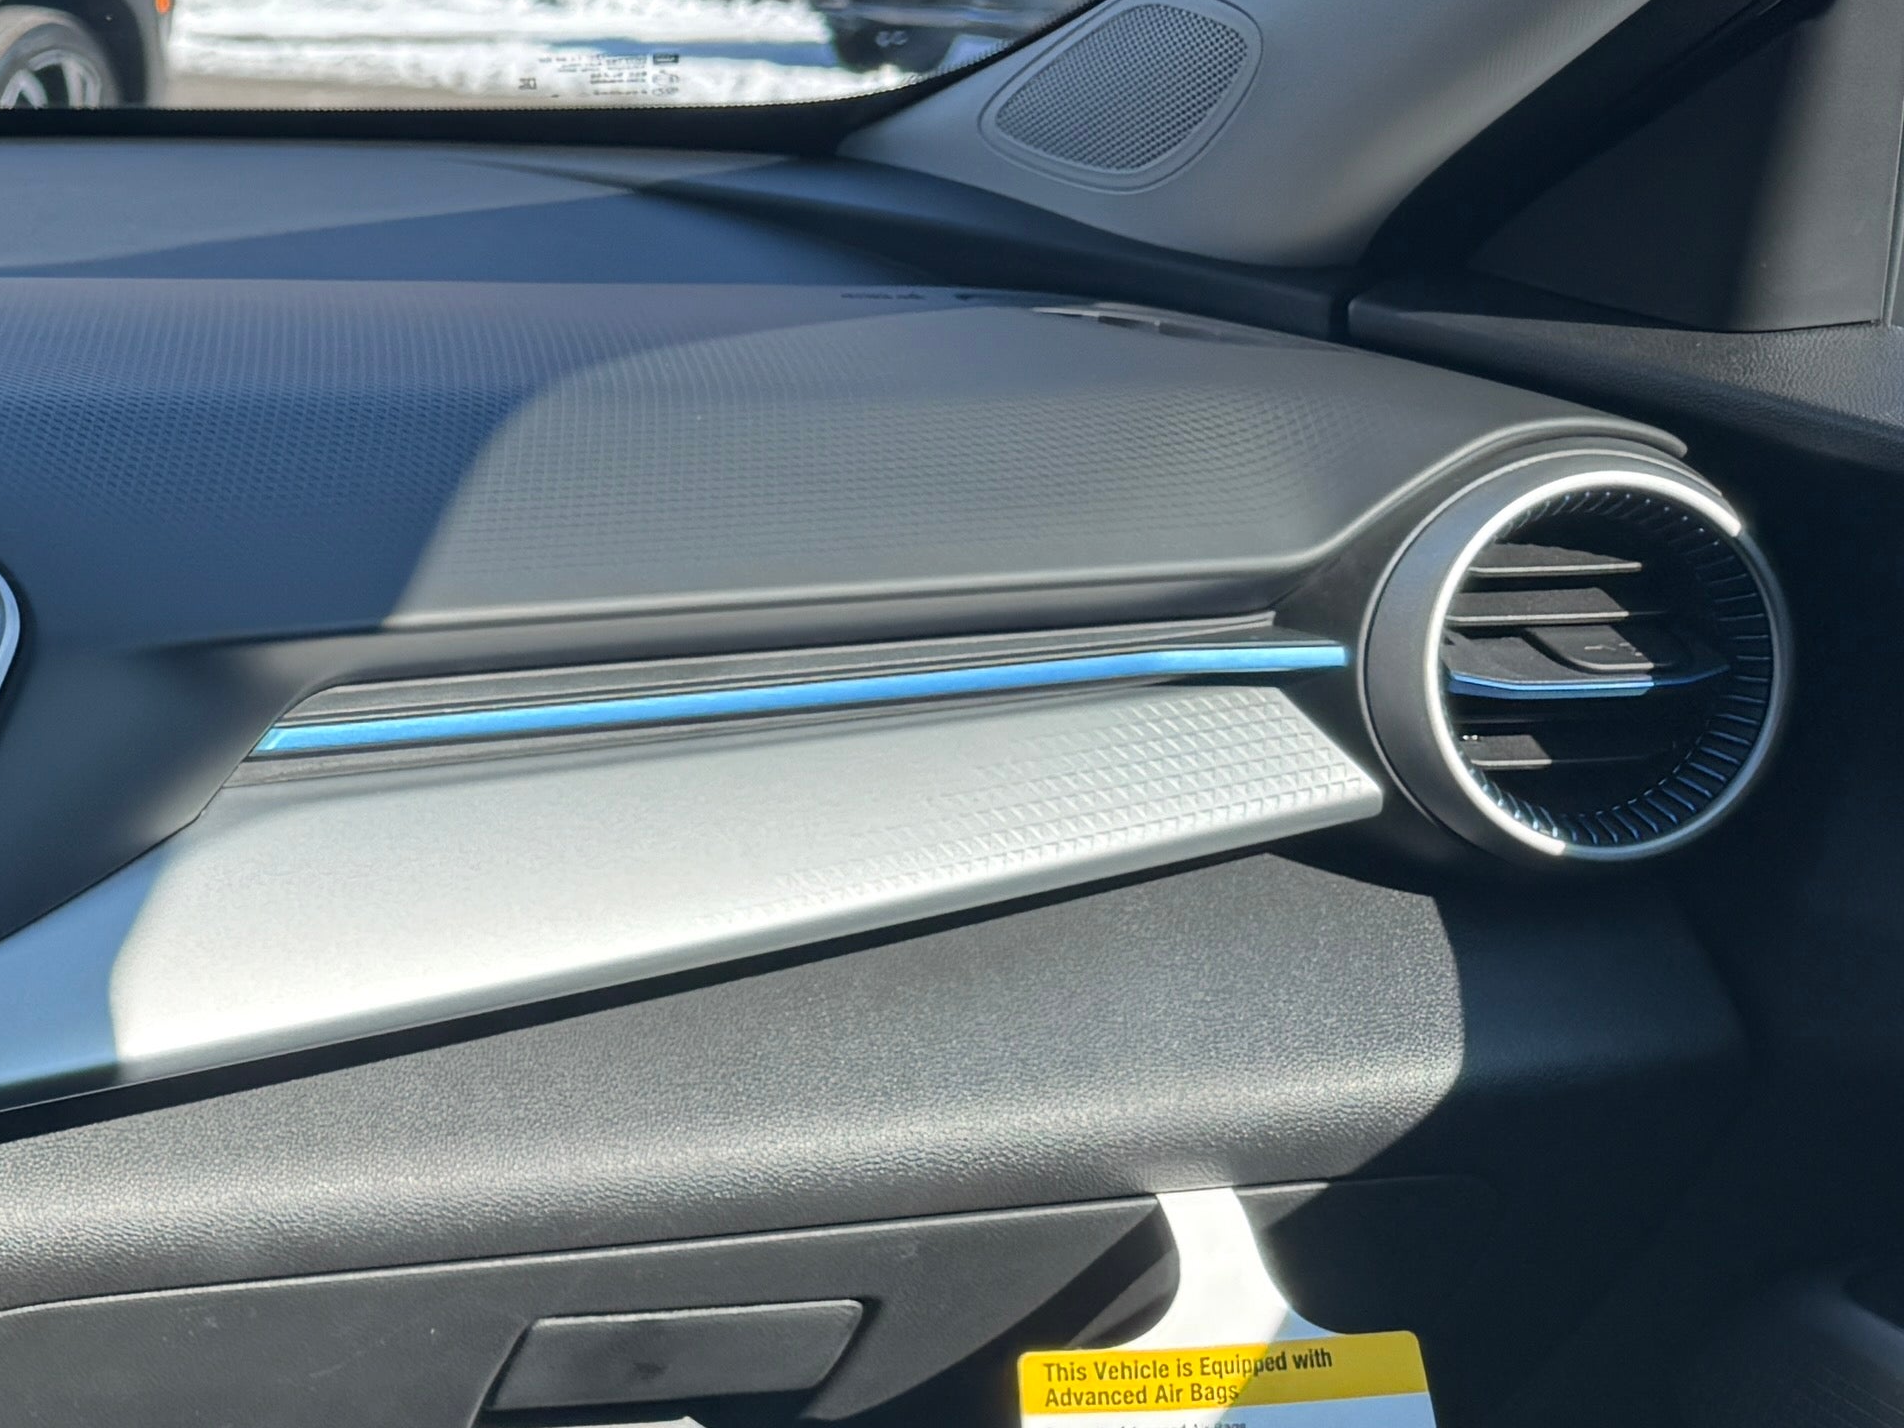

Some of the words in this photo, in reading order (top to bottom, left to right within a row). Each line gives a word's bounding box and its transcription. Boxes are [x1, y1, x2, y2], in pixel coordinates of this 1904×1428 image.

[1043, 1362, 1088, 1383] This
[1092, 1359, 1171, 1382] Vehicle
[1176, 1357, 1193, 1379] is
[1199, 1351, 1288, 1380] Equipped
[1291, 1347, 1333, 1370] with
[1044, 1384, 1148, 1408] Advanced
[1155, 1383, 1184, 1404] Air
[1191, 1380, 1240, 1405] Bags
